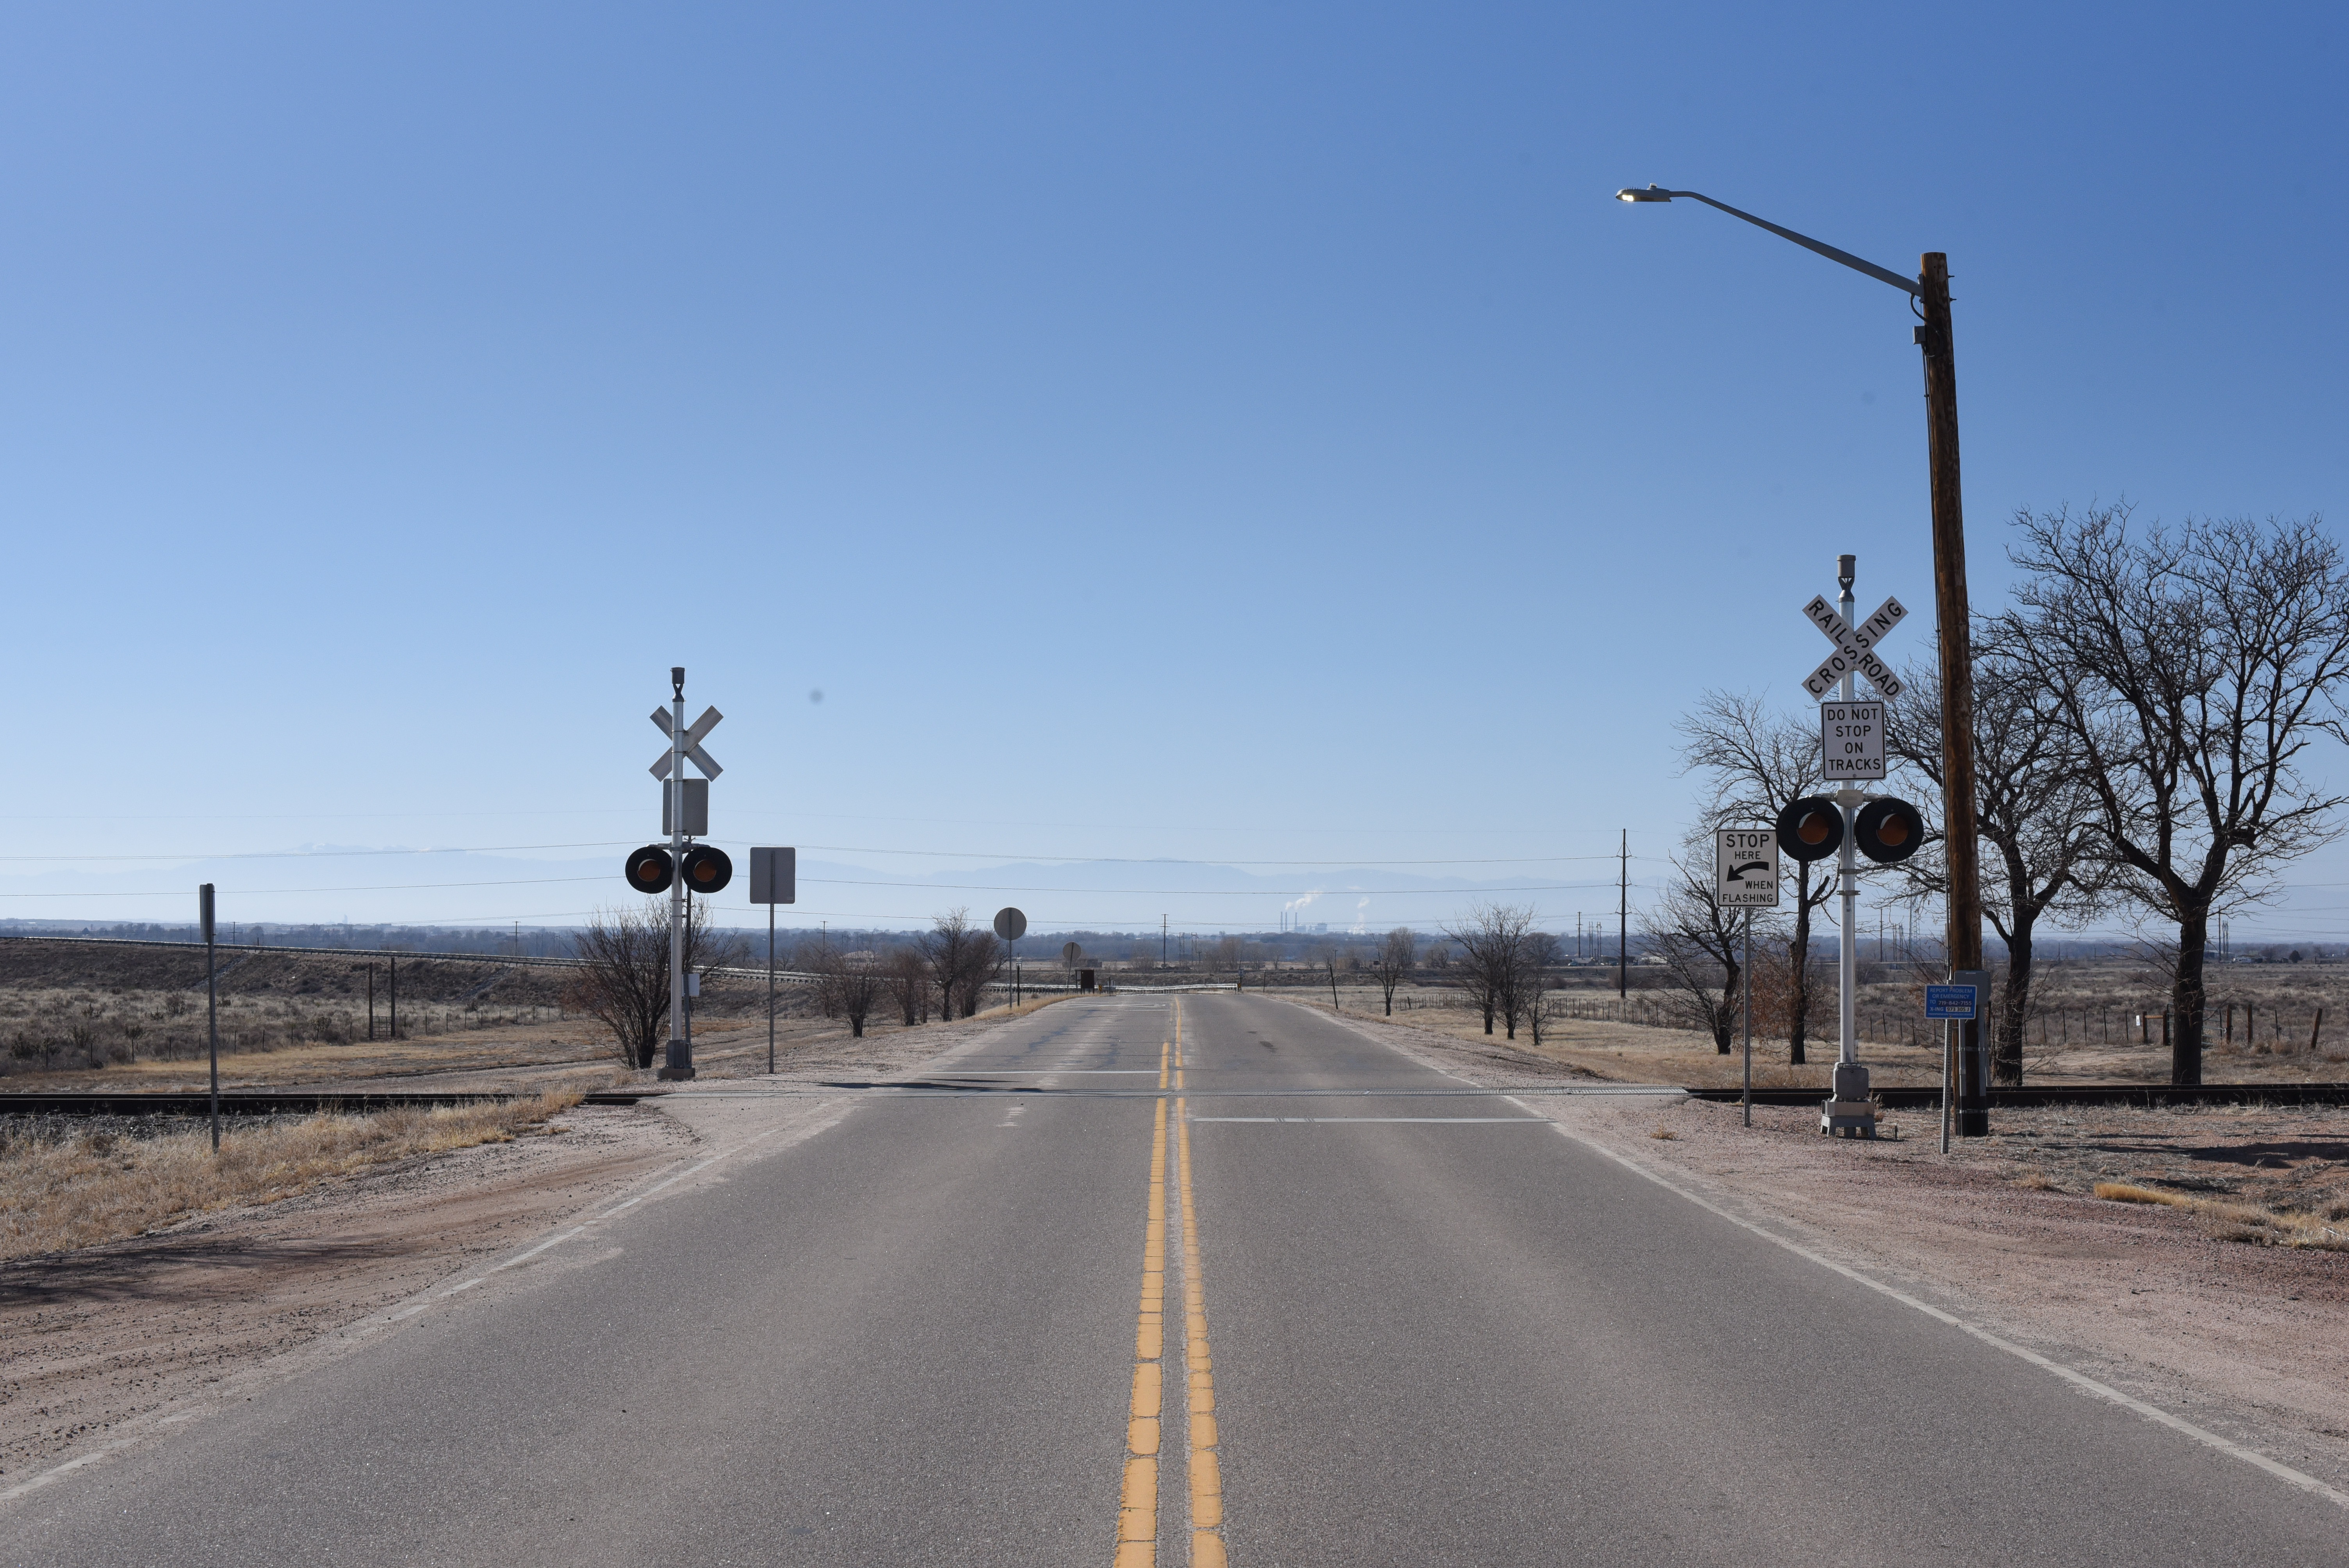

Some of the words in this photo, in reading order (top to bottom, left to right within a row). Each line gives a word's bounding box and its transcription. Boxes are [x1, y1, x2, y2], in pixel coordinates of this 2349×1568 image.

[1808, 602, 1902, 693] CROSSING
[1828, 709, 1845, 720] DO
[1852, 708, 1878, 720] NOT
[1836, 725, 1871, 737] STOP
[1845, 742, 1863, 754] ON
[1829, 758, 1880, 771] TRACKS
[1726, 834, 1770, 848] STOP
[1735, 851, 1761, 859] HERE
[1745, 881, 1773, 889] WHEN
[1723, 894, 1773, 902] FLASHING
